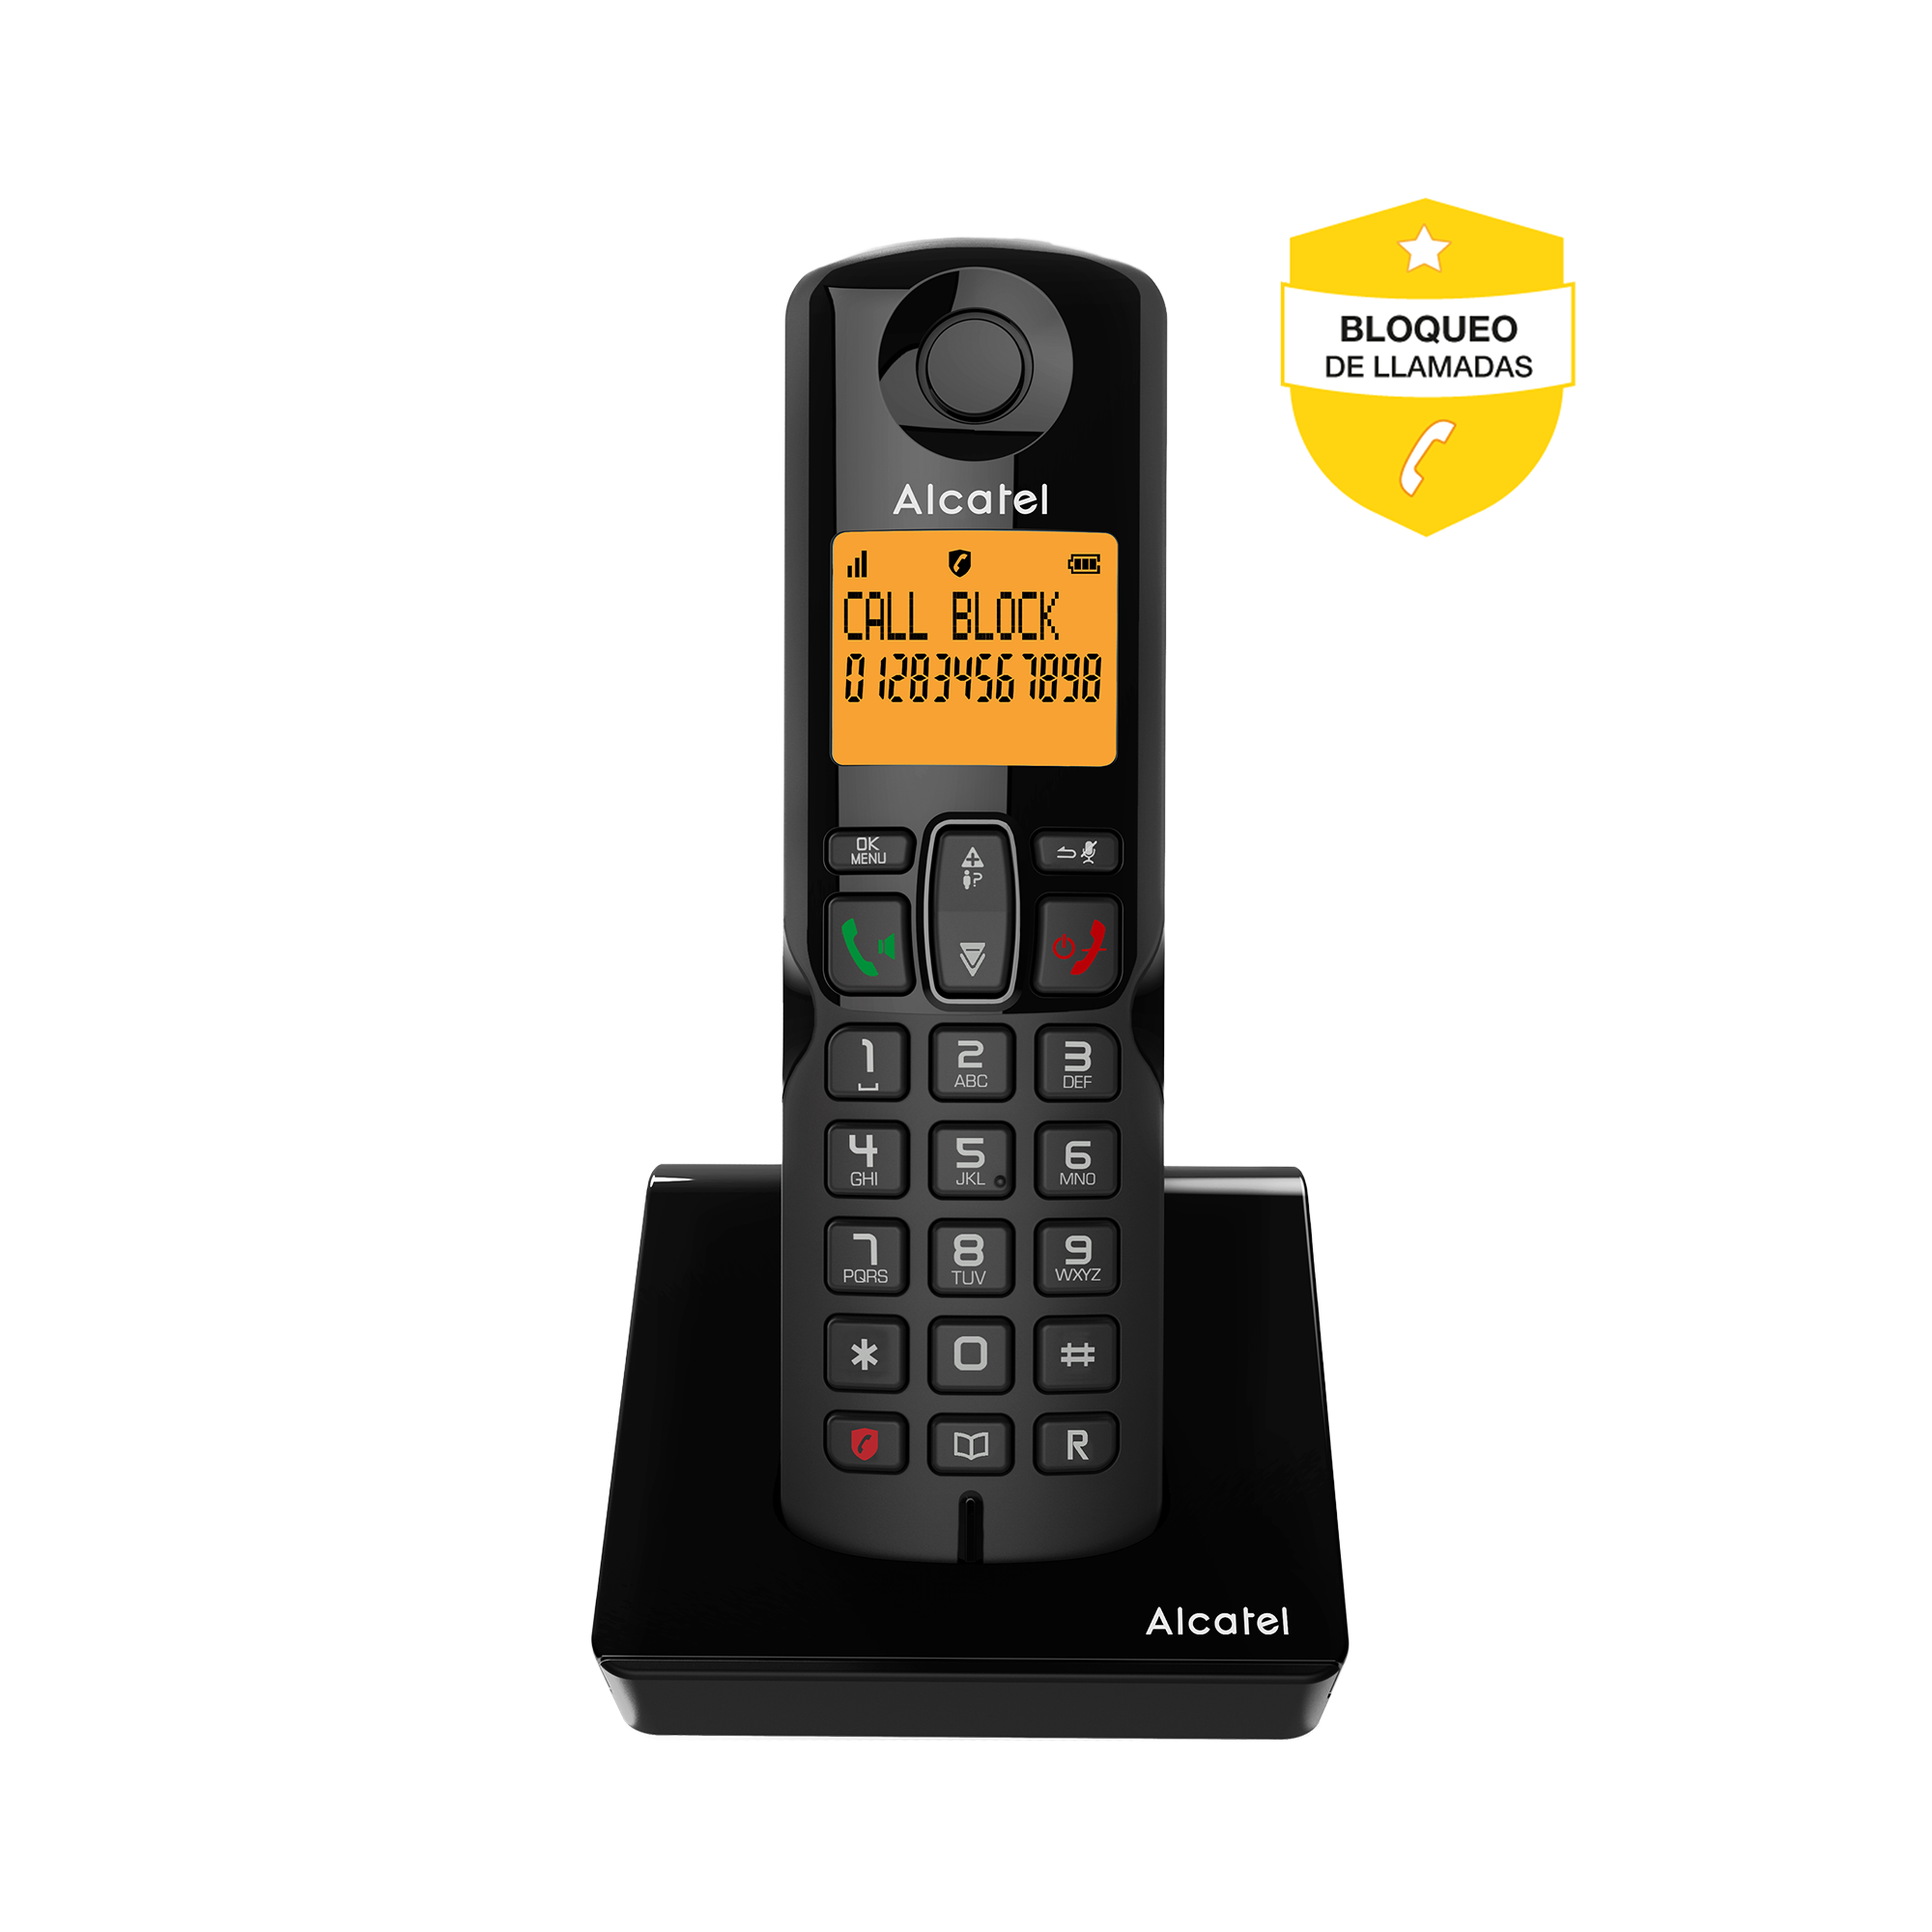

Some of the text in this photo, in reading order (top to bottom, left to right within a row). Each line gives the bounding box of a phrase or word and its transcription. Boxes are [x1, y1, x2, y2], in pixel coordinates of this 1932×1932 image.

[893, 483, 1048, 515] Alcatel
[843, 590, 1060, 641] CALL BLOCK
[856, 836, 880, 851] OK
[851, 852, 887, 866] MENU
[862, 1038, 874, 1073] 1
[957, 1039, 984, 1068] 2
[1065, 1040, 1092, 1072] 3
[953, 1073, 988, 1088] ABC
[1063, 1075, 1093, 1089] DEF
[848, 1134, 878, 1168] 4
[955, 1137, 985, 1169] 5
[1065, 1140, 1092, 1170] 6
[850, 1171, 878, 1186] GHI
[955, 1172, 986, 1185] JKL
[1060, 1172, 1096, 1185] MNO
[852, 1233, 878, 1265] 7
[953, 1234, 984, 1267] 8
[1065, 1235, 1093, 1265] 9
[843, 1268, 889, 1284] PQRS
[951, 1270, 986, 1286] TUV
[1055, 1267, 1101, 1282] WXYZ
[953, 1335, 988, 1371] 0
[1066, 1430, 1090, 1461] R
[1145, 1606, 1290, 1635] Alcatel
